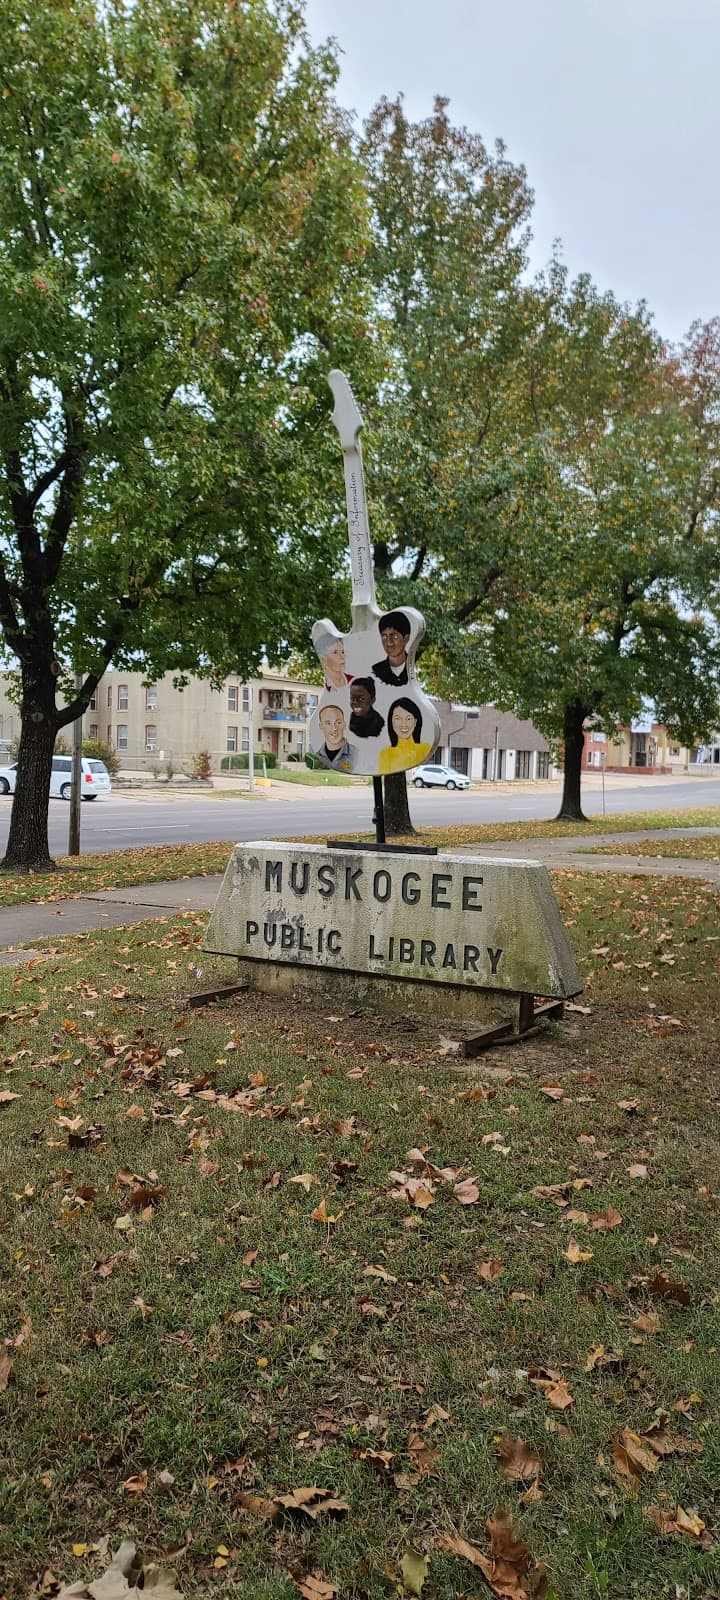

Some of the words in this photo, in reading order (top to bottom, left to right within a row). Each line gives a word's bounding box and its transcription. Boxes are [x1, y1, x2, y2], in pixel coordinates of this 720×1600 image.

[349, 472, 363, 527] Information
[352, 531, 364, 543] of
[353, 546, 366, 586] Treasury
[264, 860, 484, 912] MUSKOGEE
[246, 920, 342, 955] PUBLIC
[368, 934, 503, 975] LIBRARY
